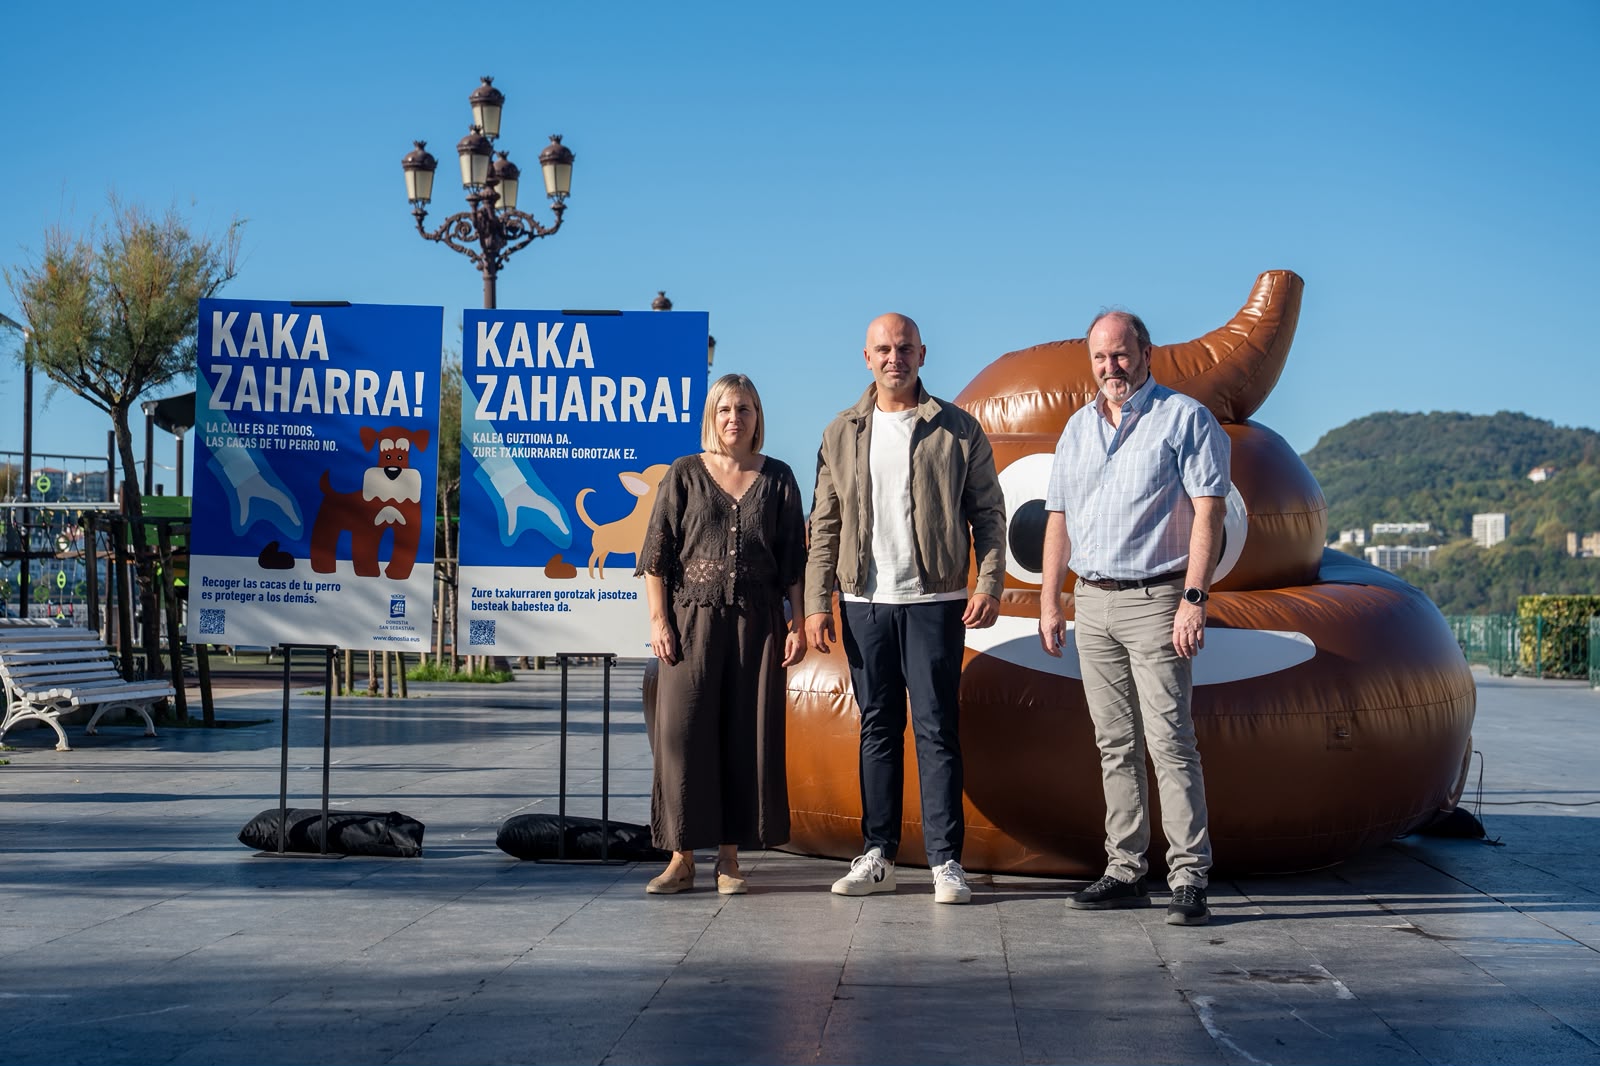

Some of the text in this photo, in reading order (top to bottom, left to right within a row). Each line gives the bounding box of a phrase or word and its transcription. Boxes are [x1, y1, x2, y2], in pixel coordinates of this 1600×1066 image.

[211, 311, 330, 361] KAKA
[476, 321, 595, 369] KAKA
[208, 364, 425, 418] ZAHARRA!
[474, 374, 691, 423] ZAHARRA!
[206, 422, 315, 437] LA CALLE ES DE TODOS,
[206, 436, 339, 451] LAS CACAS DE TU PERRO NO.
[472, 432, 572, 445] KALEA GUZTIONA DA.
[472, 446, 638, 460] ZURE TXAKURRAREN GOROTZAK EZ.
[202, 576, 341, 593] Recoger las cacas de tu perro
[202, 591, 317, 604] es proteger a los demás.
[471, 587, 637, 602] Zure txakurraren gorotzak jasotzea
[471, 600, 572, 612] besteak babestea da.
